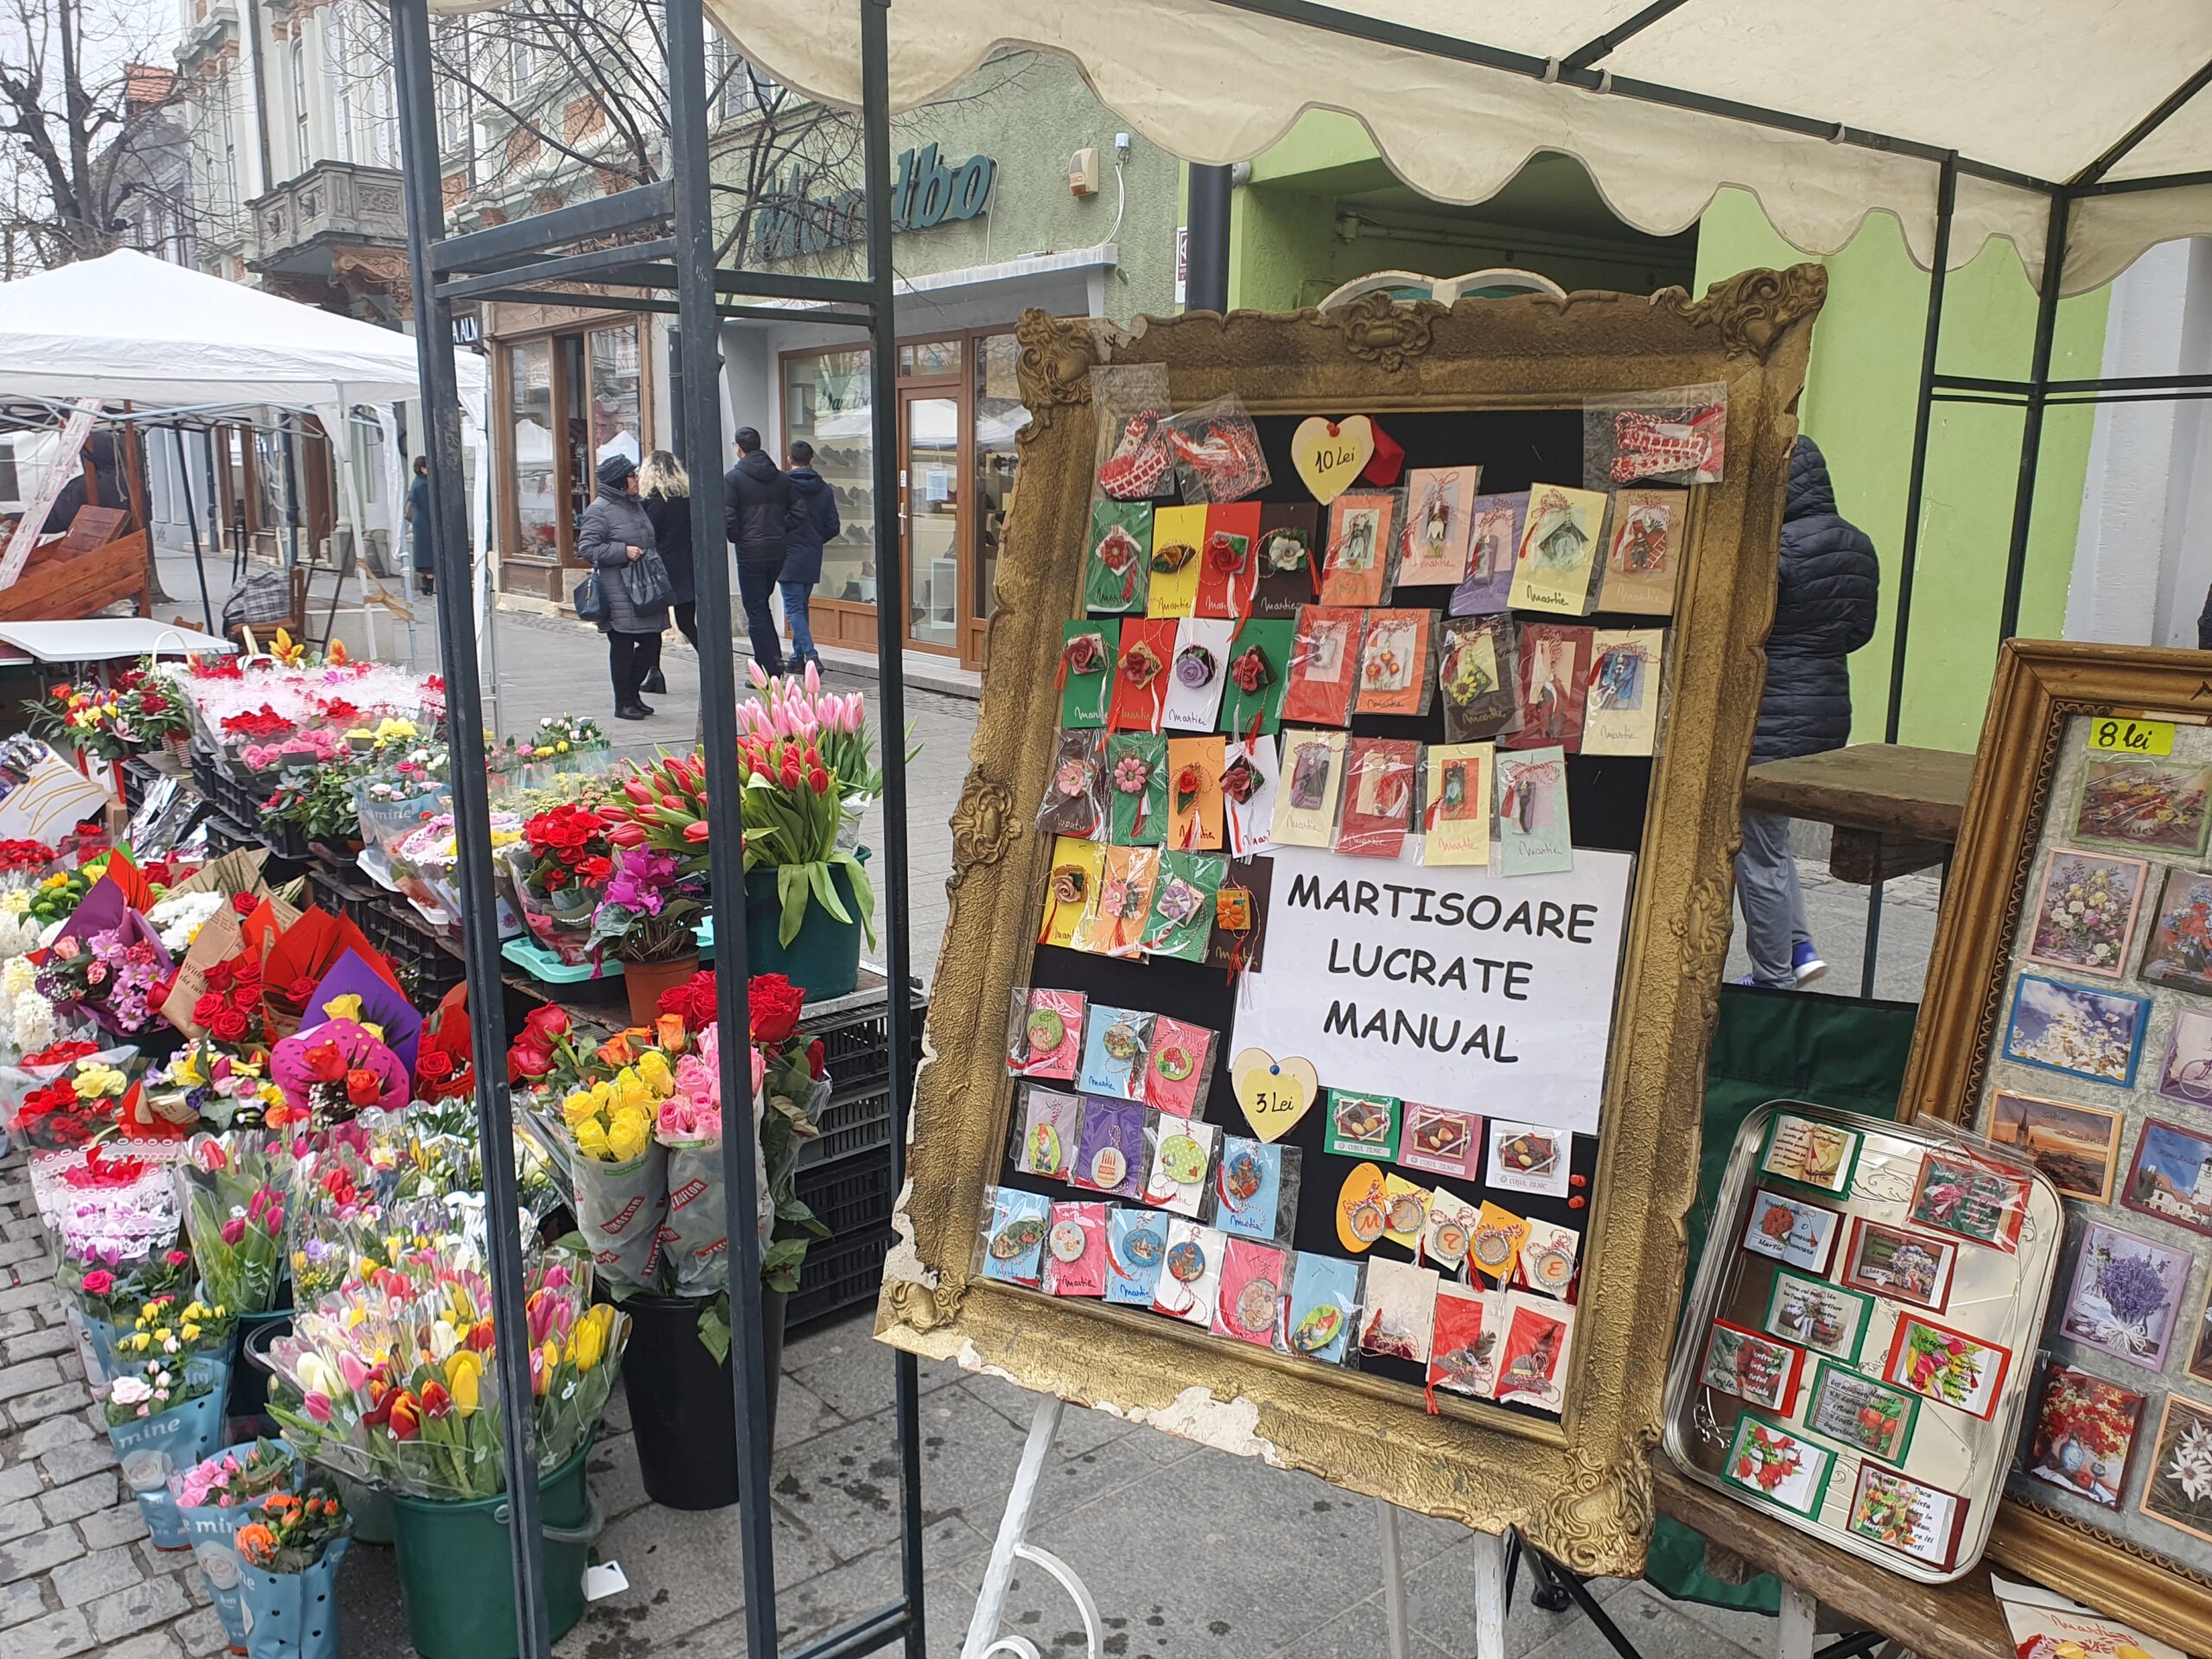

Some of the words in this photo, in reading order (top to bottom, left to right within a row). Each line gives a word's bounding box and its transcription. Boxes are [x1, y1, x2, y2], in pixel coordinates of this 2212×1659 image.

[1314, 449, 1334, 474] 10
[1337, 447, 1356, 466] Lei
[1169, 709, 1207, 726] Martie
[2098, 721, 2119, 747] 8
[2123, 722, 2153, 750] lei
[1287, 874, 1599, 944] MARTISOARE
[1328, 938, 1533, 1001] LUCRATE
[1324, 1000, 1518, 1064] MANUAL
[1255, 1093, 1268, 1113] 3
[1271, 1091, 1294, 1112] Lei
[1758, 1239, 1783, 1250] Martie
[1548, 1261, 1563, 1277] E
[118, 1417, 181, 1449] mine
